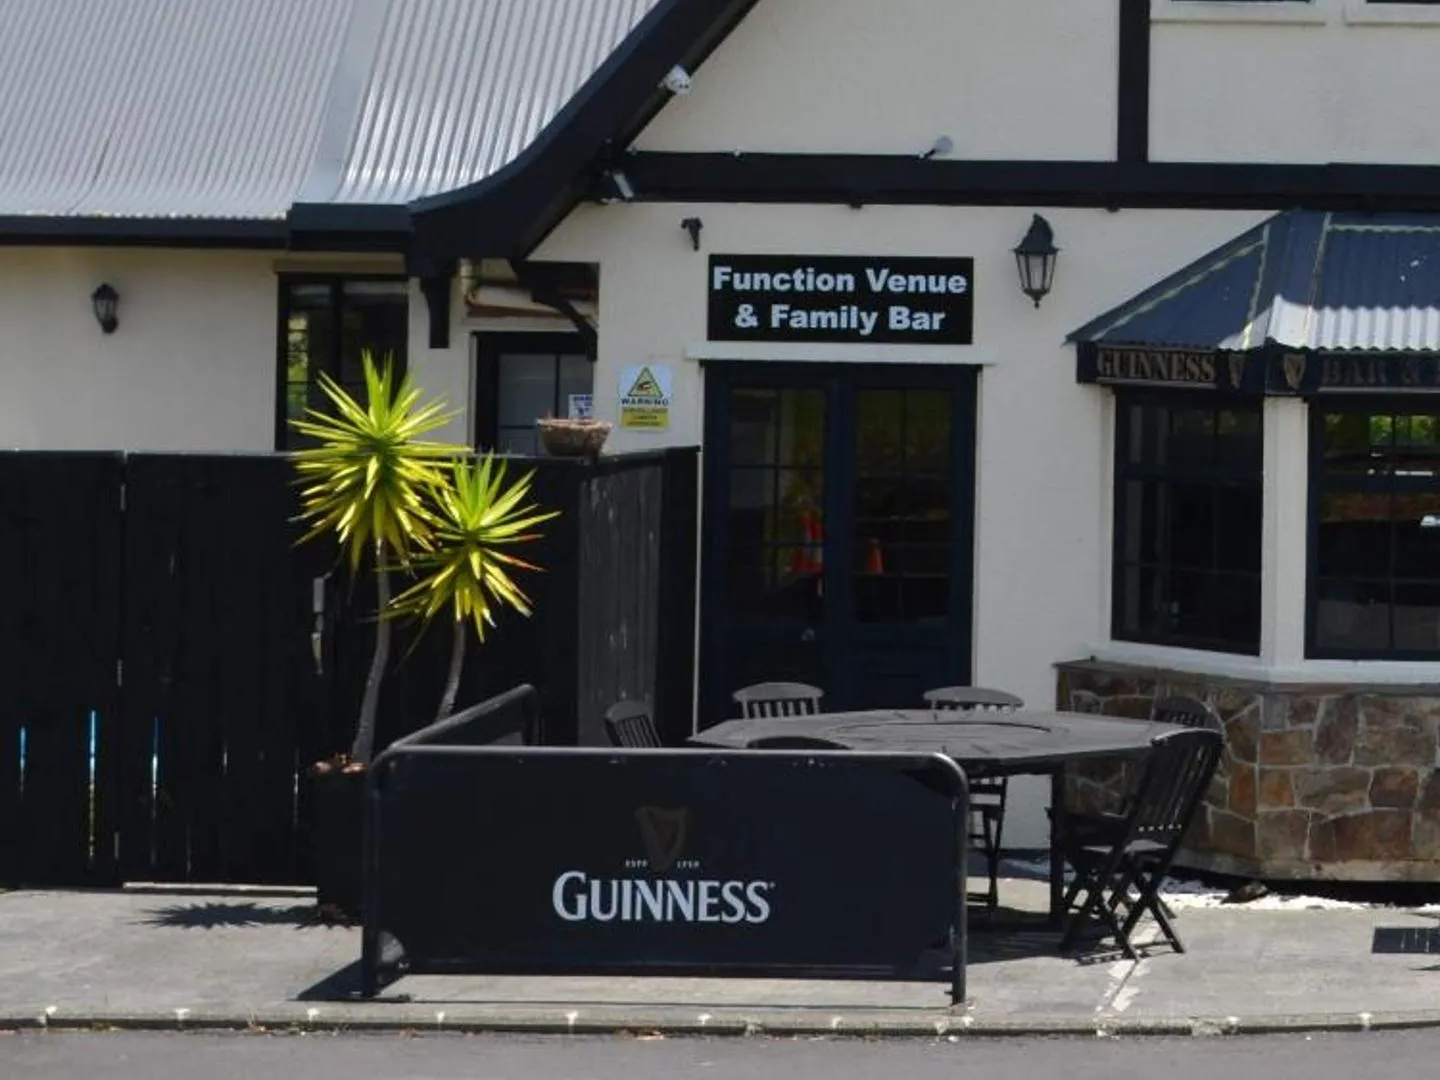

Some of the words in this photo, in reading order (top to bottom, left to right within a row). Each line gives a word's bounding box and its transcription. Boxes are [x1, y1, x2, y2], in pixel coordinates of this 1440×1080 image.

[713, 266, 855, 294] Function
[866, 269, 967, 295] Venue
[733, 304, 758, 329] &
[771, 305, 878, 336] Family
[888, 306, 945, 331] Bar
[1097, 349, 1215, 382] GUINNESS
[1321, 359, 1388, 384] BAR
[621, 398, 669, 406] WARNING
[552, 871, 770, 923] GUINNESS
